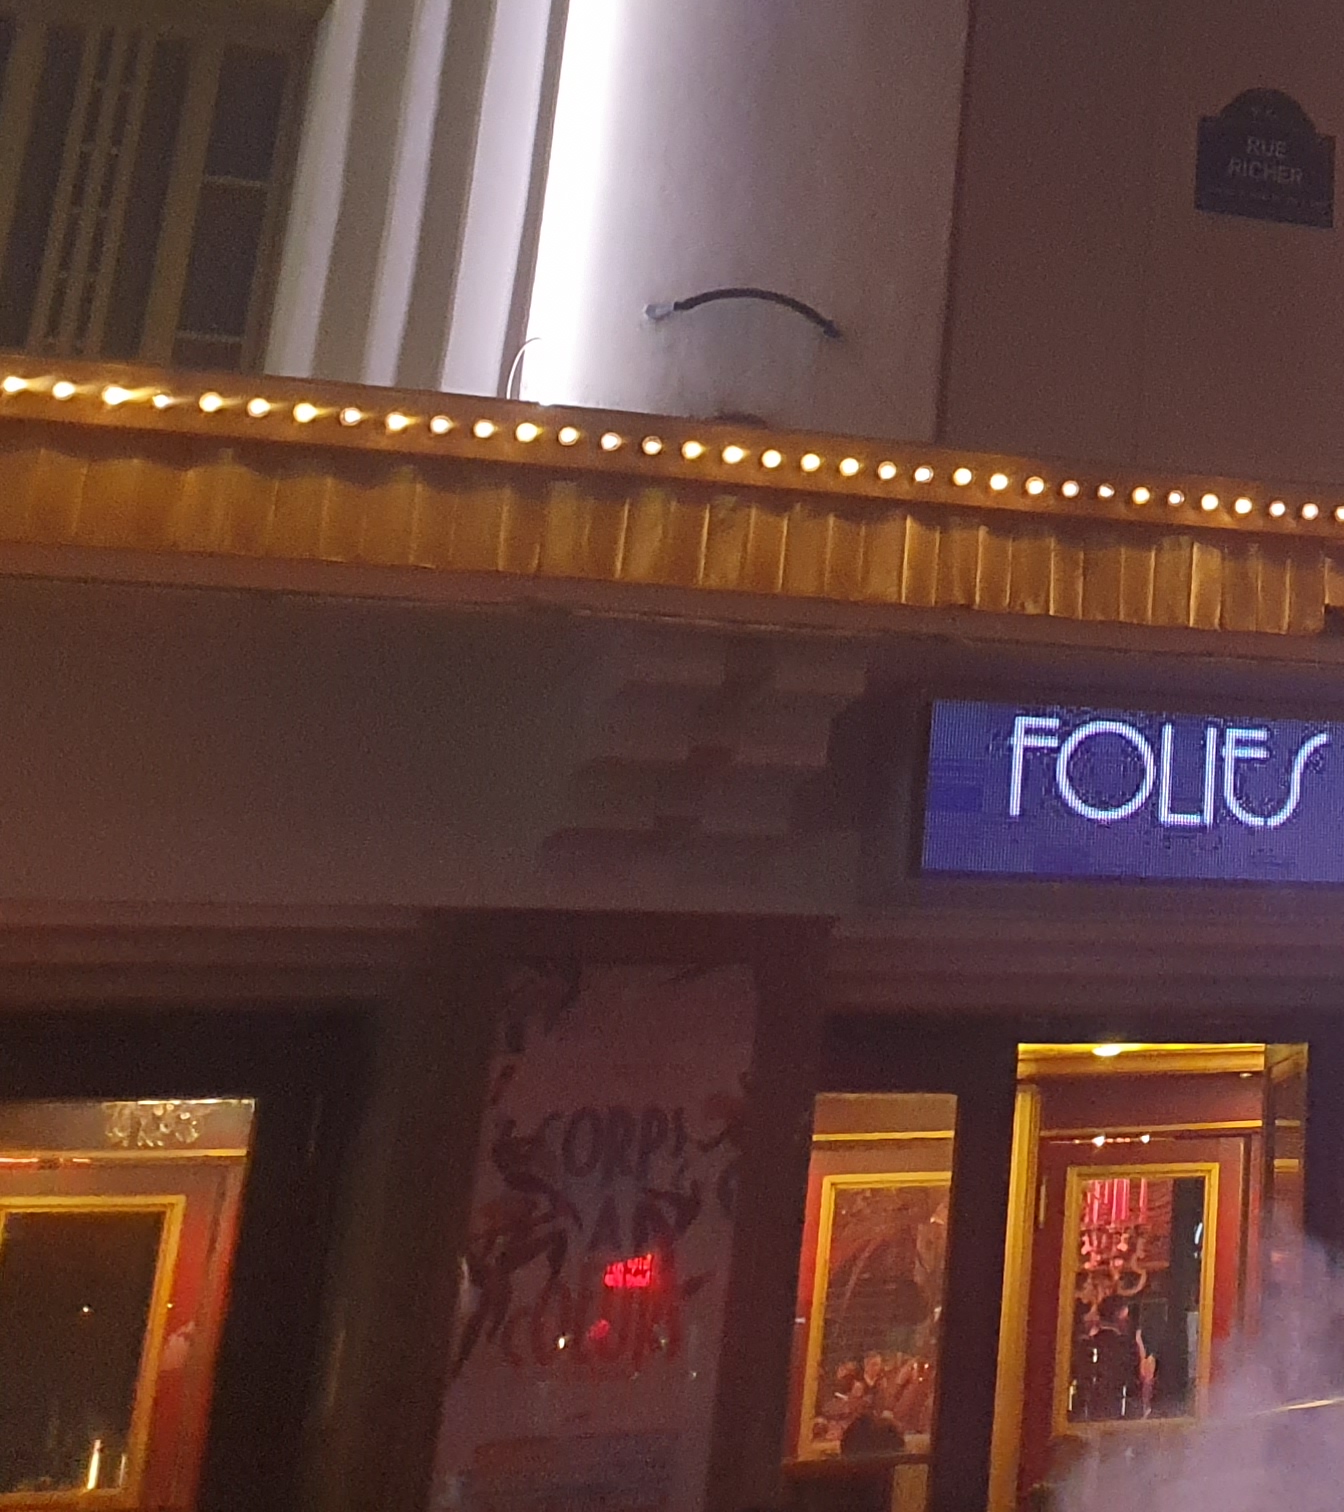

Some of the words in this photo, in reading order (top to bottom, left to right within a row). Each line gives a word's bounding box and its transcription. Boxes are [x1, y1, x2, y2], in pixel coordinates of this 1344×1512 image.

[1247, 137, 1288, 159] RUE
[1227, 157, 1303, 185] RICHER
[1010, 716, 1329, 828] FOLIES
